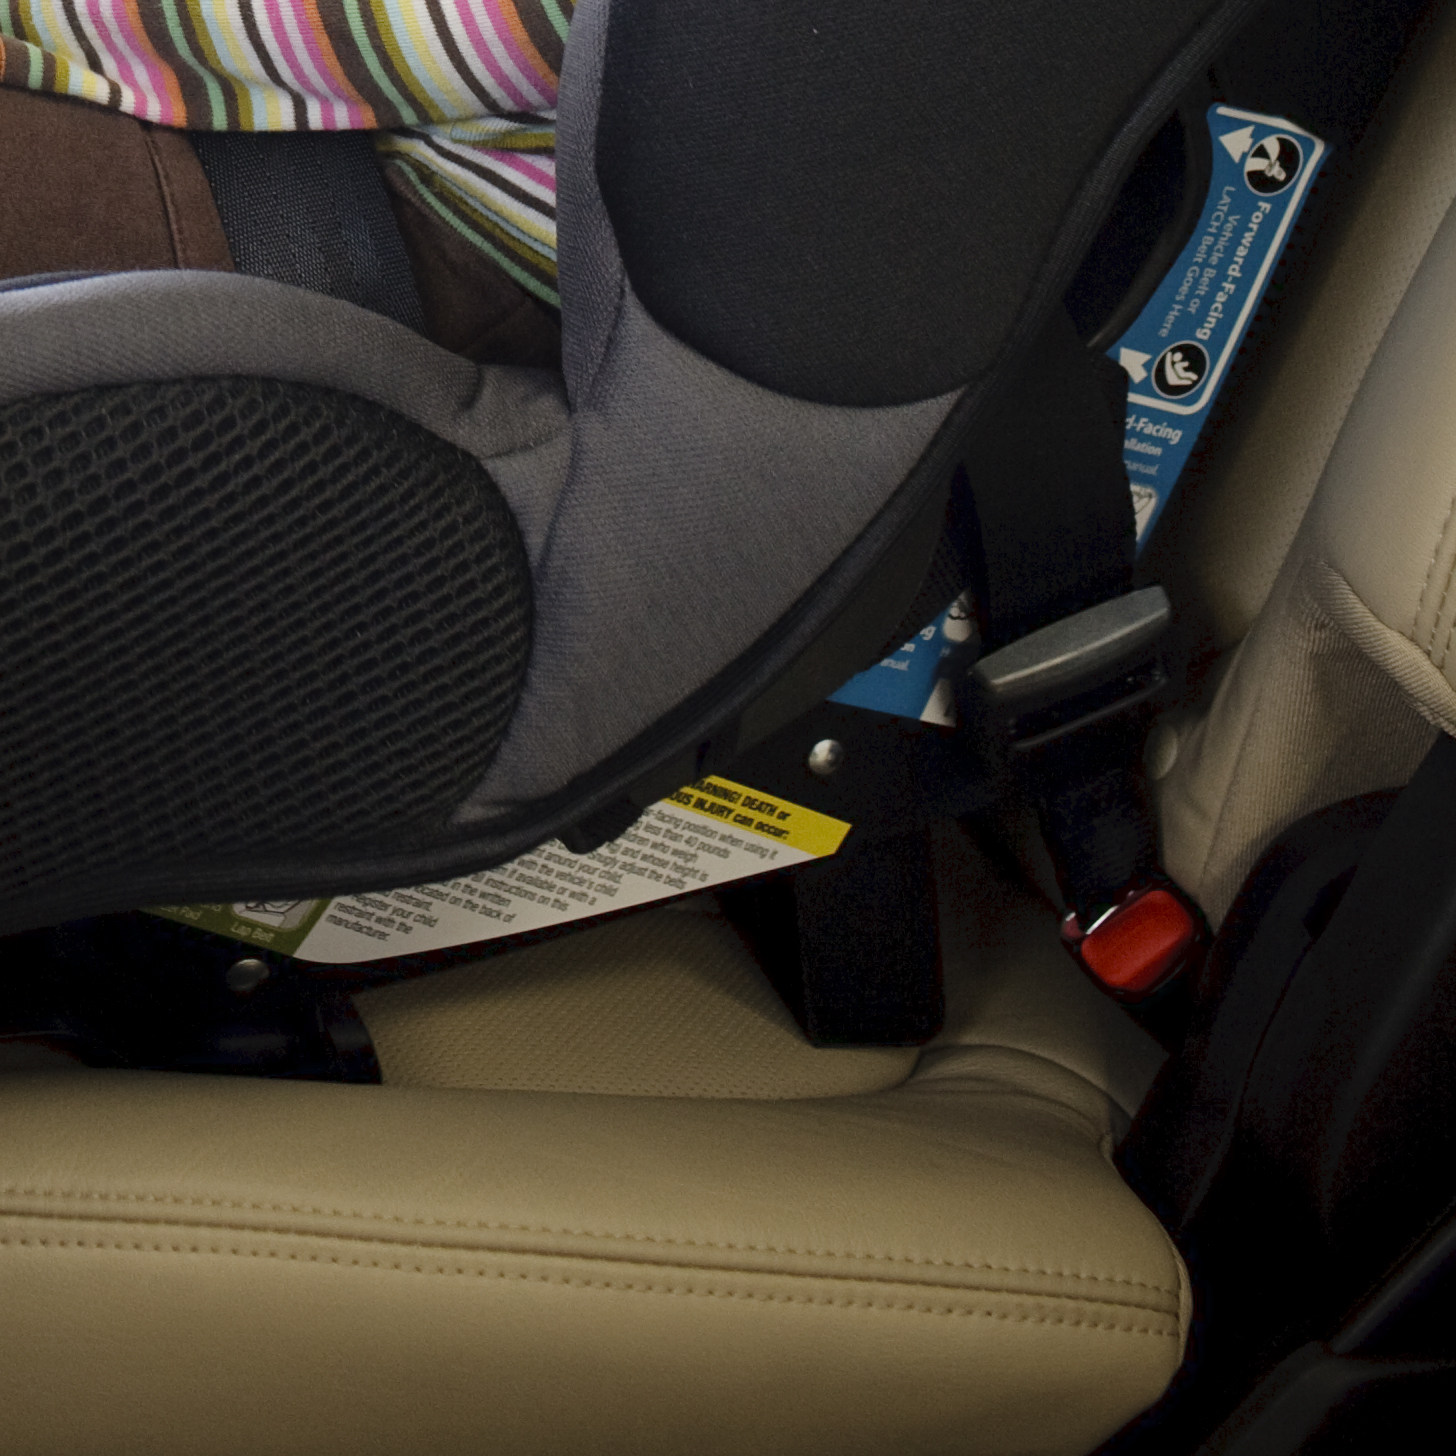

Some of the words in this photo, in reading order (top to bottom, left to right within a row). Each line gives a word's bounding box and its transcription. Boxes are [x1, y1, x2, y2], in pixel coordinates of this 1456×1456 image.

[1207, 185, 1236, 234] LATCH
[1193, 235, 1215, 263] Belt
[1208, 215, 1241, 266] Vehicle
[1175, 265, 1201, 302] Goes
[1194, 267, 1217, 296] Belt
[1195, 200, 1272, 341] Forward-Facing
[1157, 303, 1184, 338] Here
[1187, 298, 1201, 315] or
[1125, 414, 1183, 445] d-Facing
[693, 779, 742, 804] ARNING!
[741, 795, 778, 817] DEATH
[776, 811, 791, 821] or
[693, 797, 735, 819] INJURY
[732, 813, 755, 828] can
[662, 828, 684, 844] than
[696, 841, 731, 860] pounds
[681, 821, 719, 840] position
[718, 833, 745, 849] when
[744, 842, 770, 860] using
[620, 846, 643, 860] and
[640, 853, 671, 869] whose
